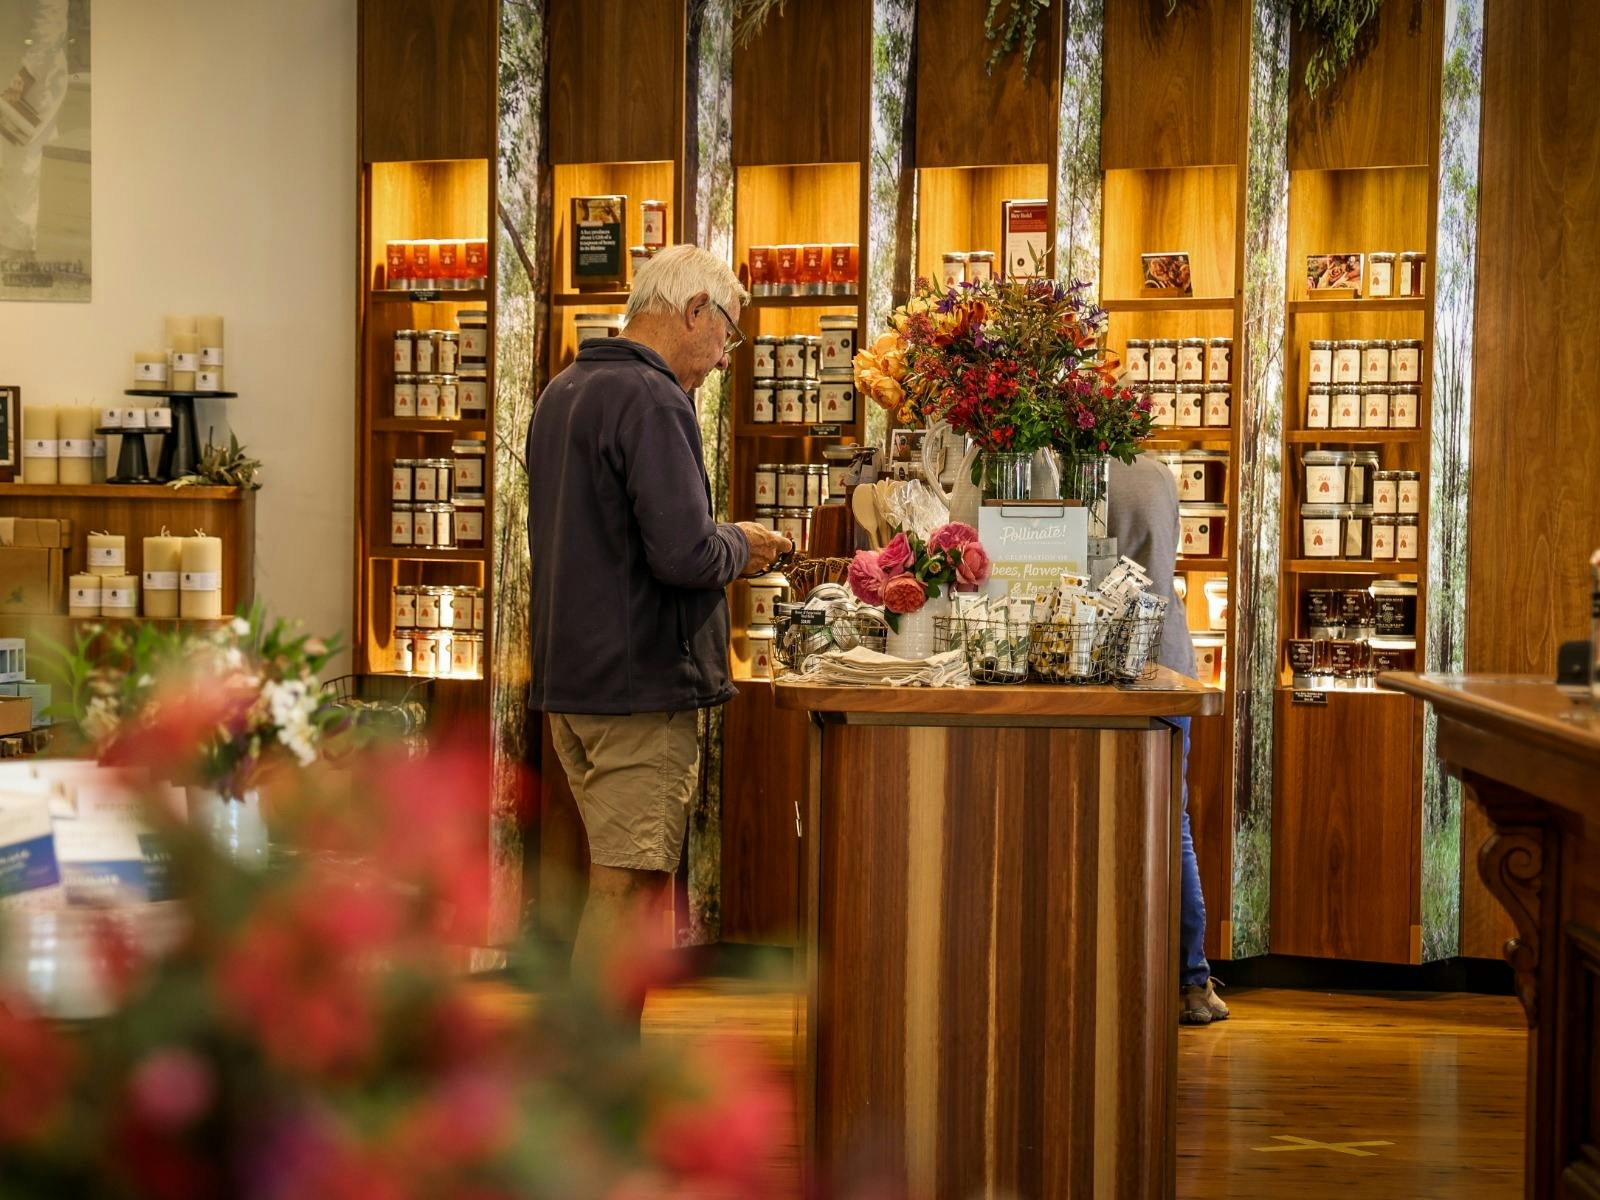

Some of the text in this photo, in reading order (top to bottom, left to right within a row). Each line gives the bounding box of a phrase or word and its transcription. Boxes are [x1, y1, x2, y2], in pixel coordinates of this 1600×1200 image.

[1000, 524, 1066, 546] Pollinate!
[992, 563, 1021, 578] bees,
[1011, 582, 1022, 595] &
